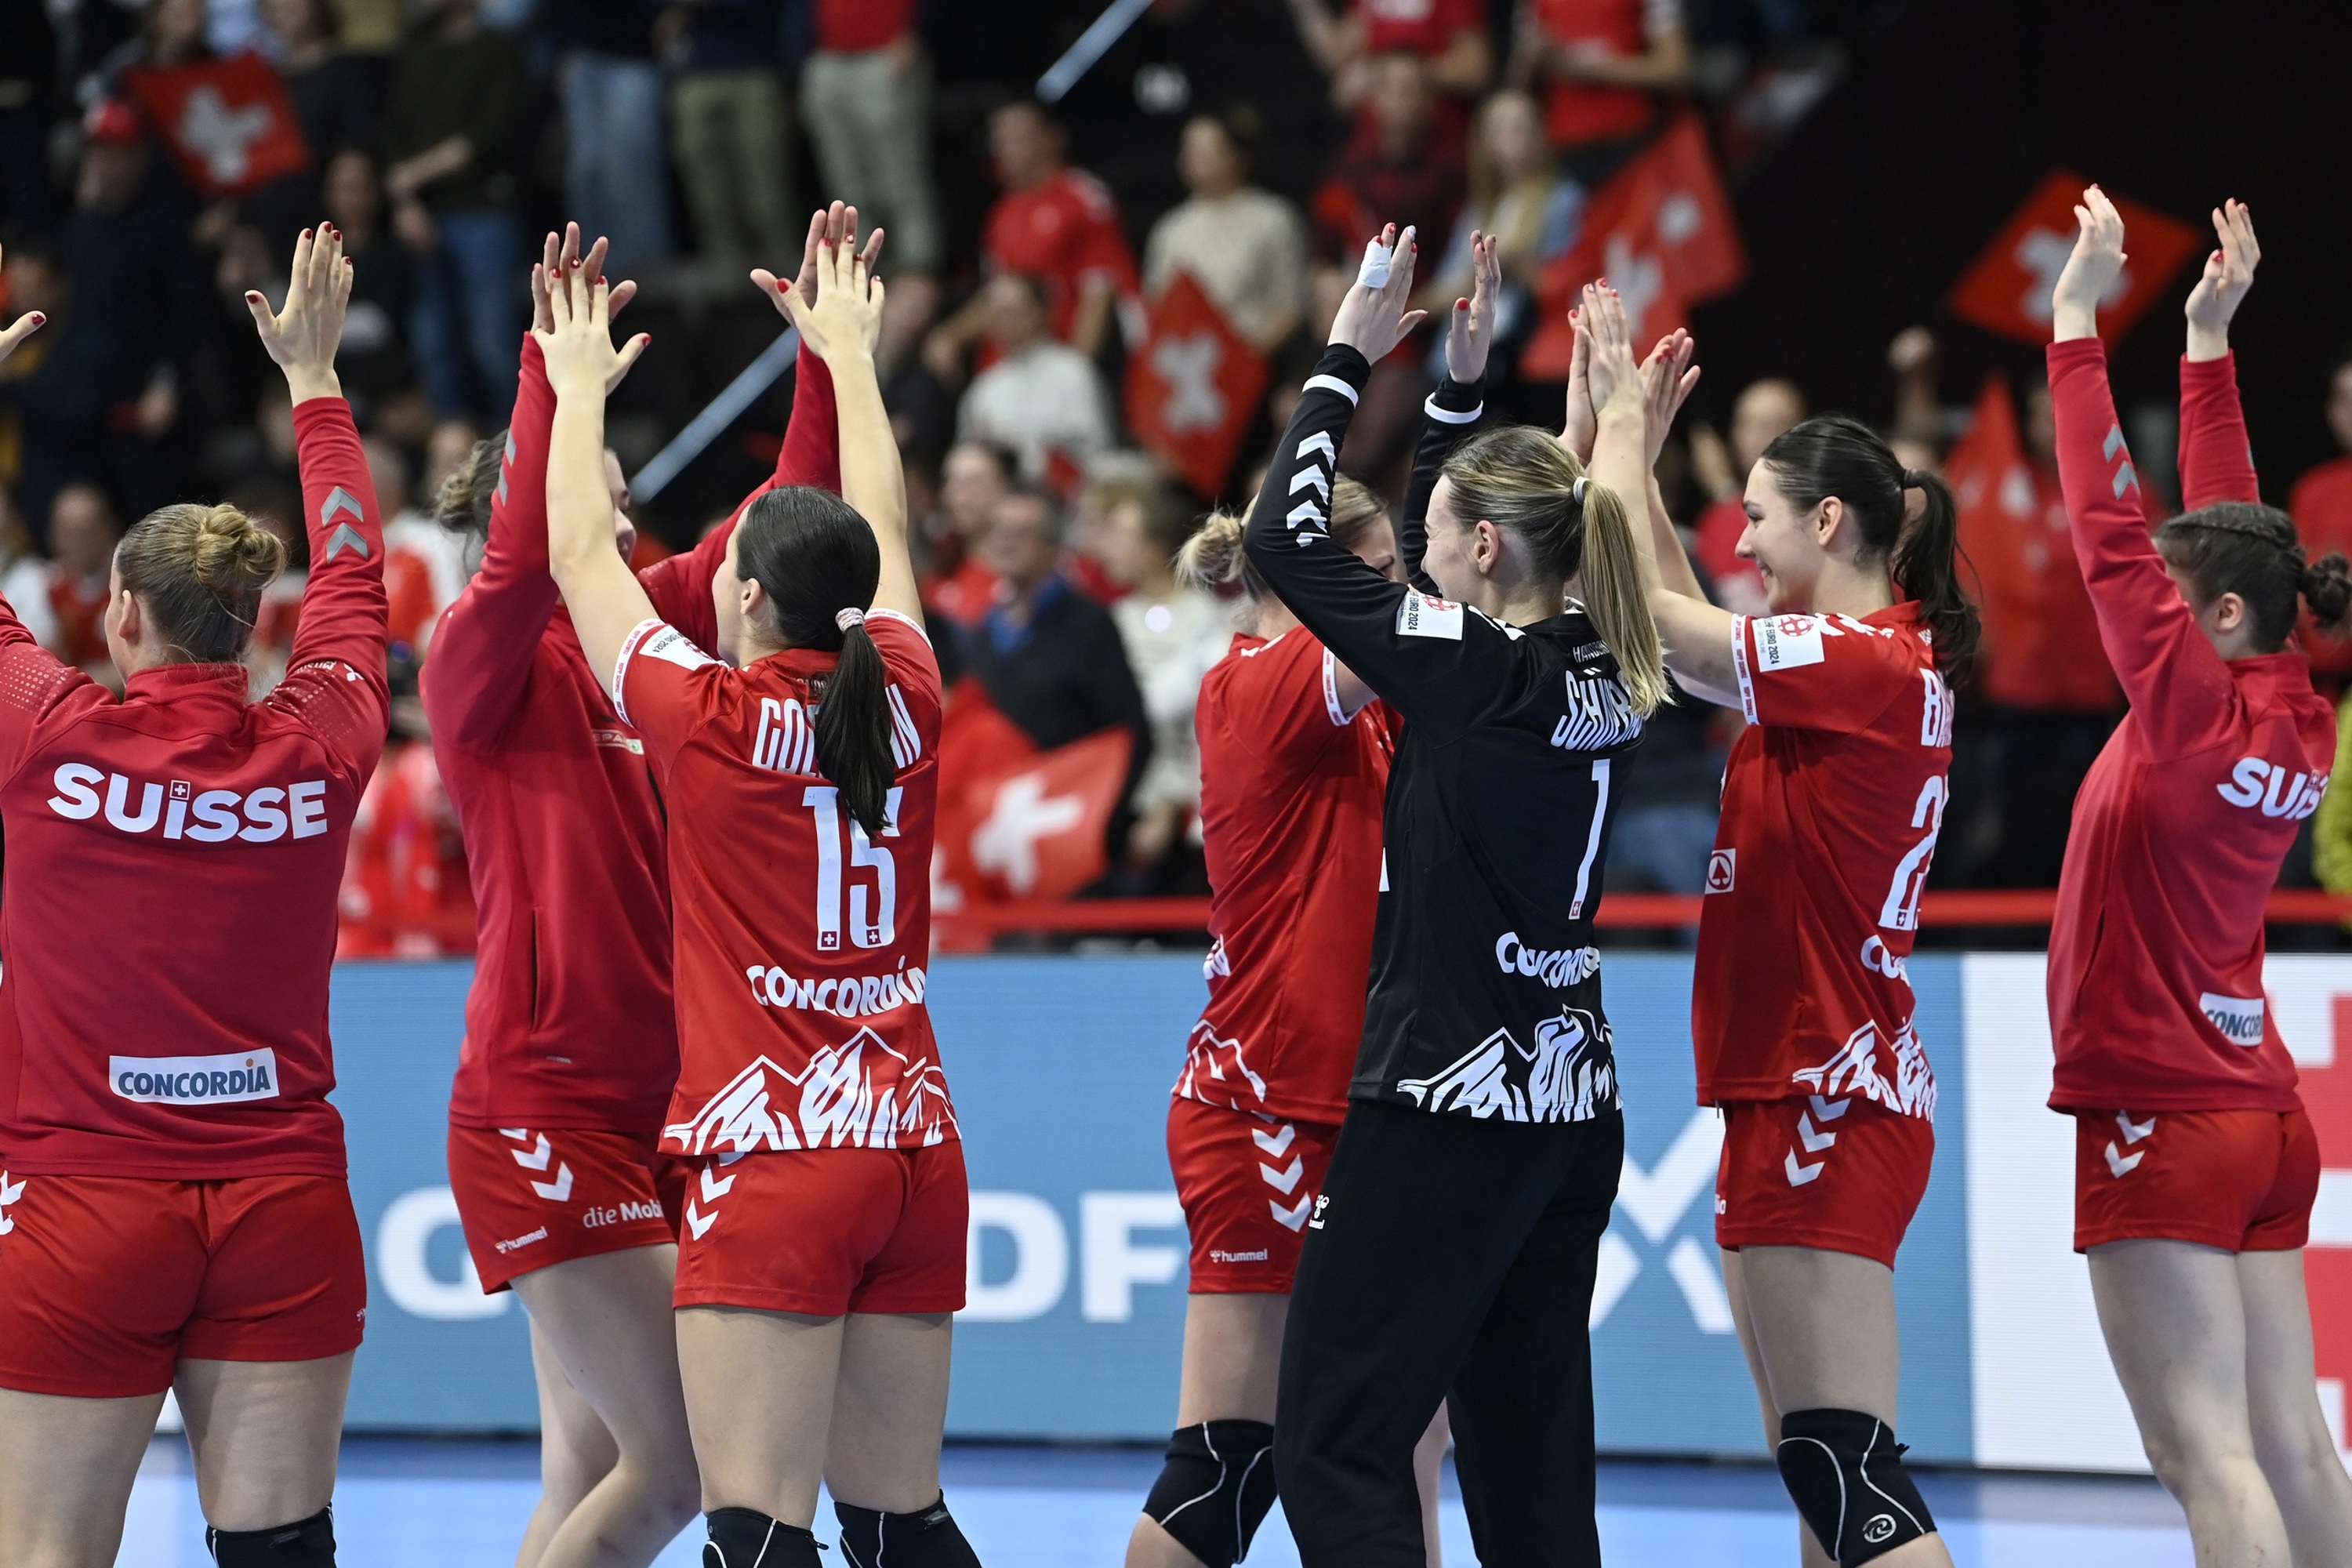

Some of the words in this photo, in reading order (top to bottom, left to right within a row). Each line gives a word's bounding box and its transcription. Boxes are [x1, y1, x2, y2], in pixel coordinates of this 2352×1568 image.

[1408, 612, 1419, 630] 2024
[1766, 630, 1777, 645] EURO
[1768, 645, 1780, 665] 2024
[1568, 758, 1610, 920] 1
[802, 786, 903, 951] 15
[583, 1207, 618, 1229] die
[505, 1225, 549, 1251] hummel
[1221, 1248, 1269, 1263] hummel
